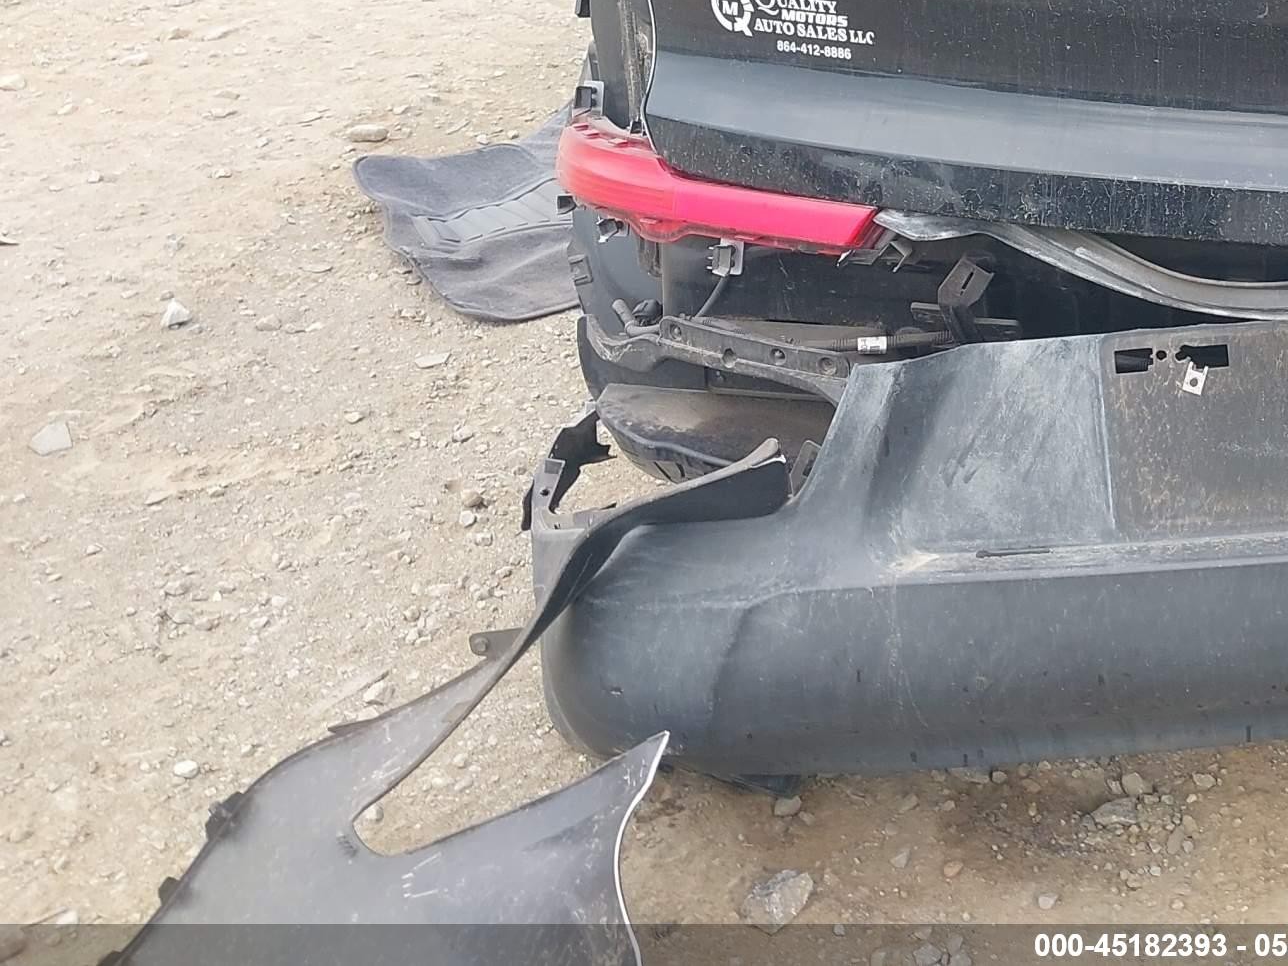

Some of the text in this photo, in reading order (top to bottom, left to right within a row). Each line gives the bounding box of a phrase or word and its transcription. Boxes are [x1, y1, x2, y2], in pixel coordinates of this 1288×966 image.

[781, 9, 848, 27] MOTORS
[754, 18, 875, 45] AUTO SALES LLC
